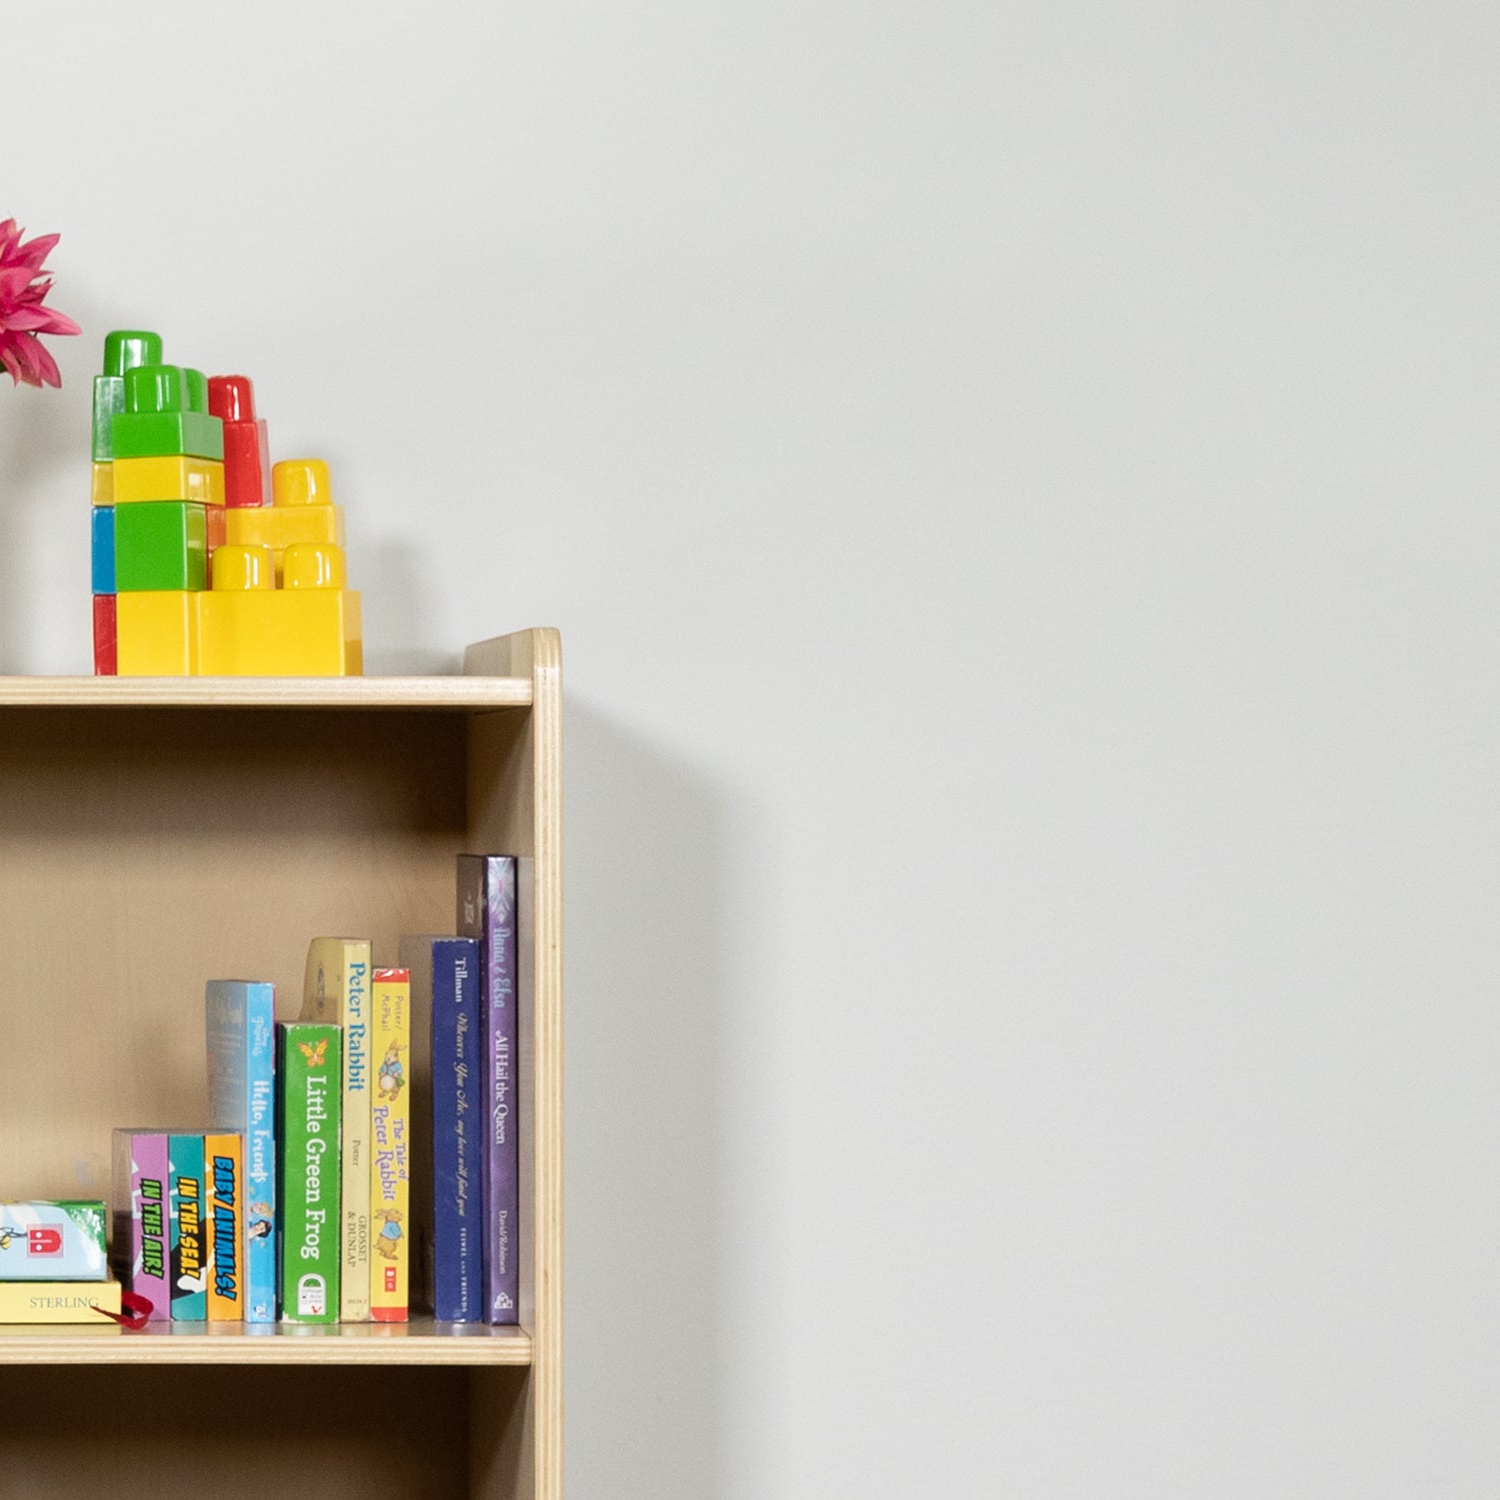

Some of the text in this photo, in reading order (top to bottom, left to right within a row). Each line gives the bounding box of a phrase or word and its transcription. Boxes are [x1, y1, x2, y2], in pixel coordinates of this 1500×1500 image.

[455, 957, 467, 1002] Tillman
[493, 927, 511, 1008] Anna Elsa
[349, 963, 365, 1091] Peter Rabbit
[494, 1030, 508, 1144] All Hail the Queen
[301, 1076, 326, 1260] Little Green Frog
[352, 1140, 361, 1166] Potter
[373, 1106, 395, 1200] Peter Rabbit
[393, 1119, 409, 1181] The Tale of
[141, 1178, 164, 1279] IN THE AIR!
[177, 1177, 200, 1280] IN THE SEA!
[213, 1156, 236, 1301] BABY ANIMALS!
[347, 1211, 356, 1268] & DUNLAP
[359, 1216, 367, 1264] GROSSET
[30, 1298, 99, 1308] STERLING
